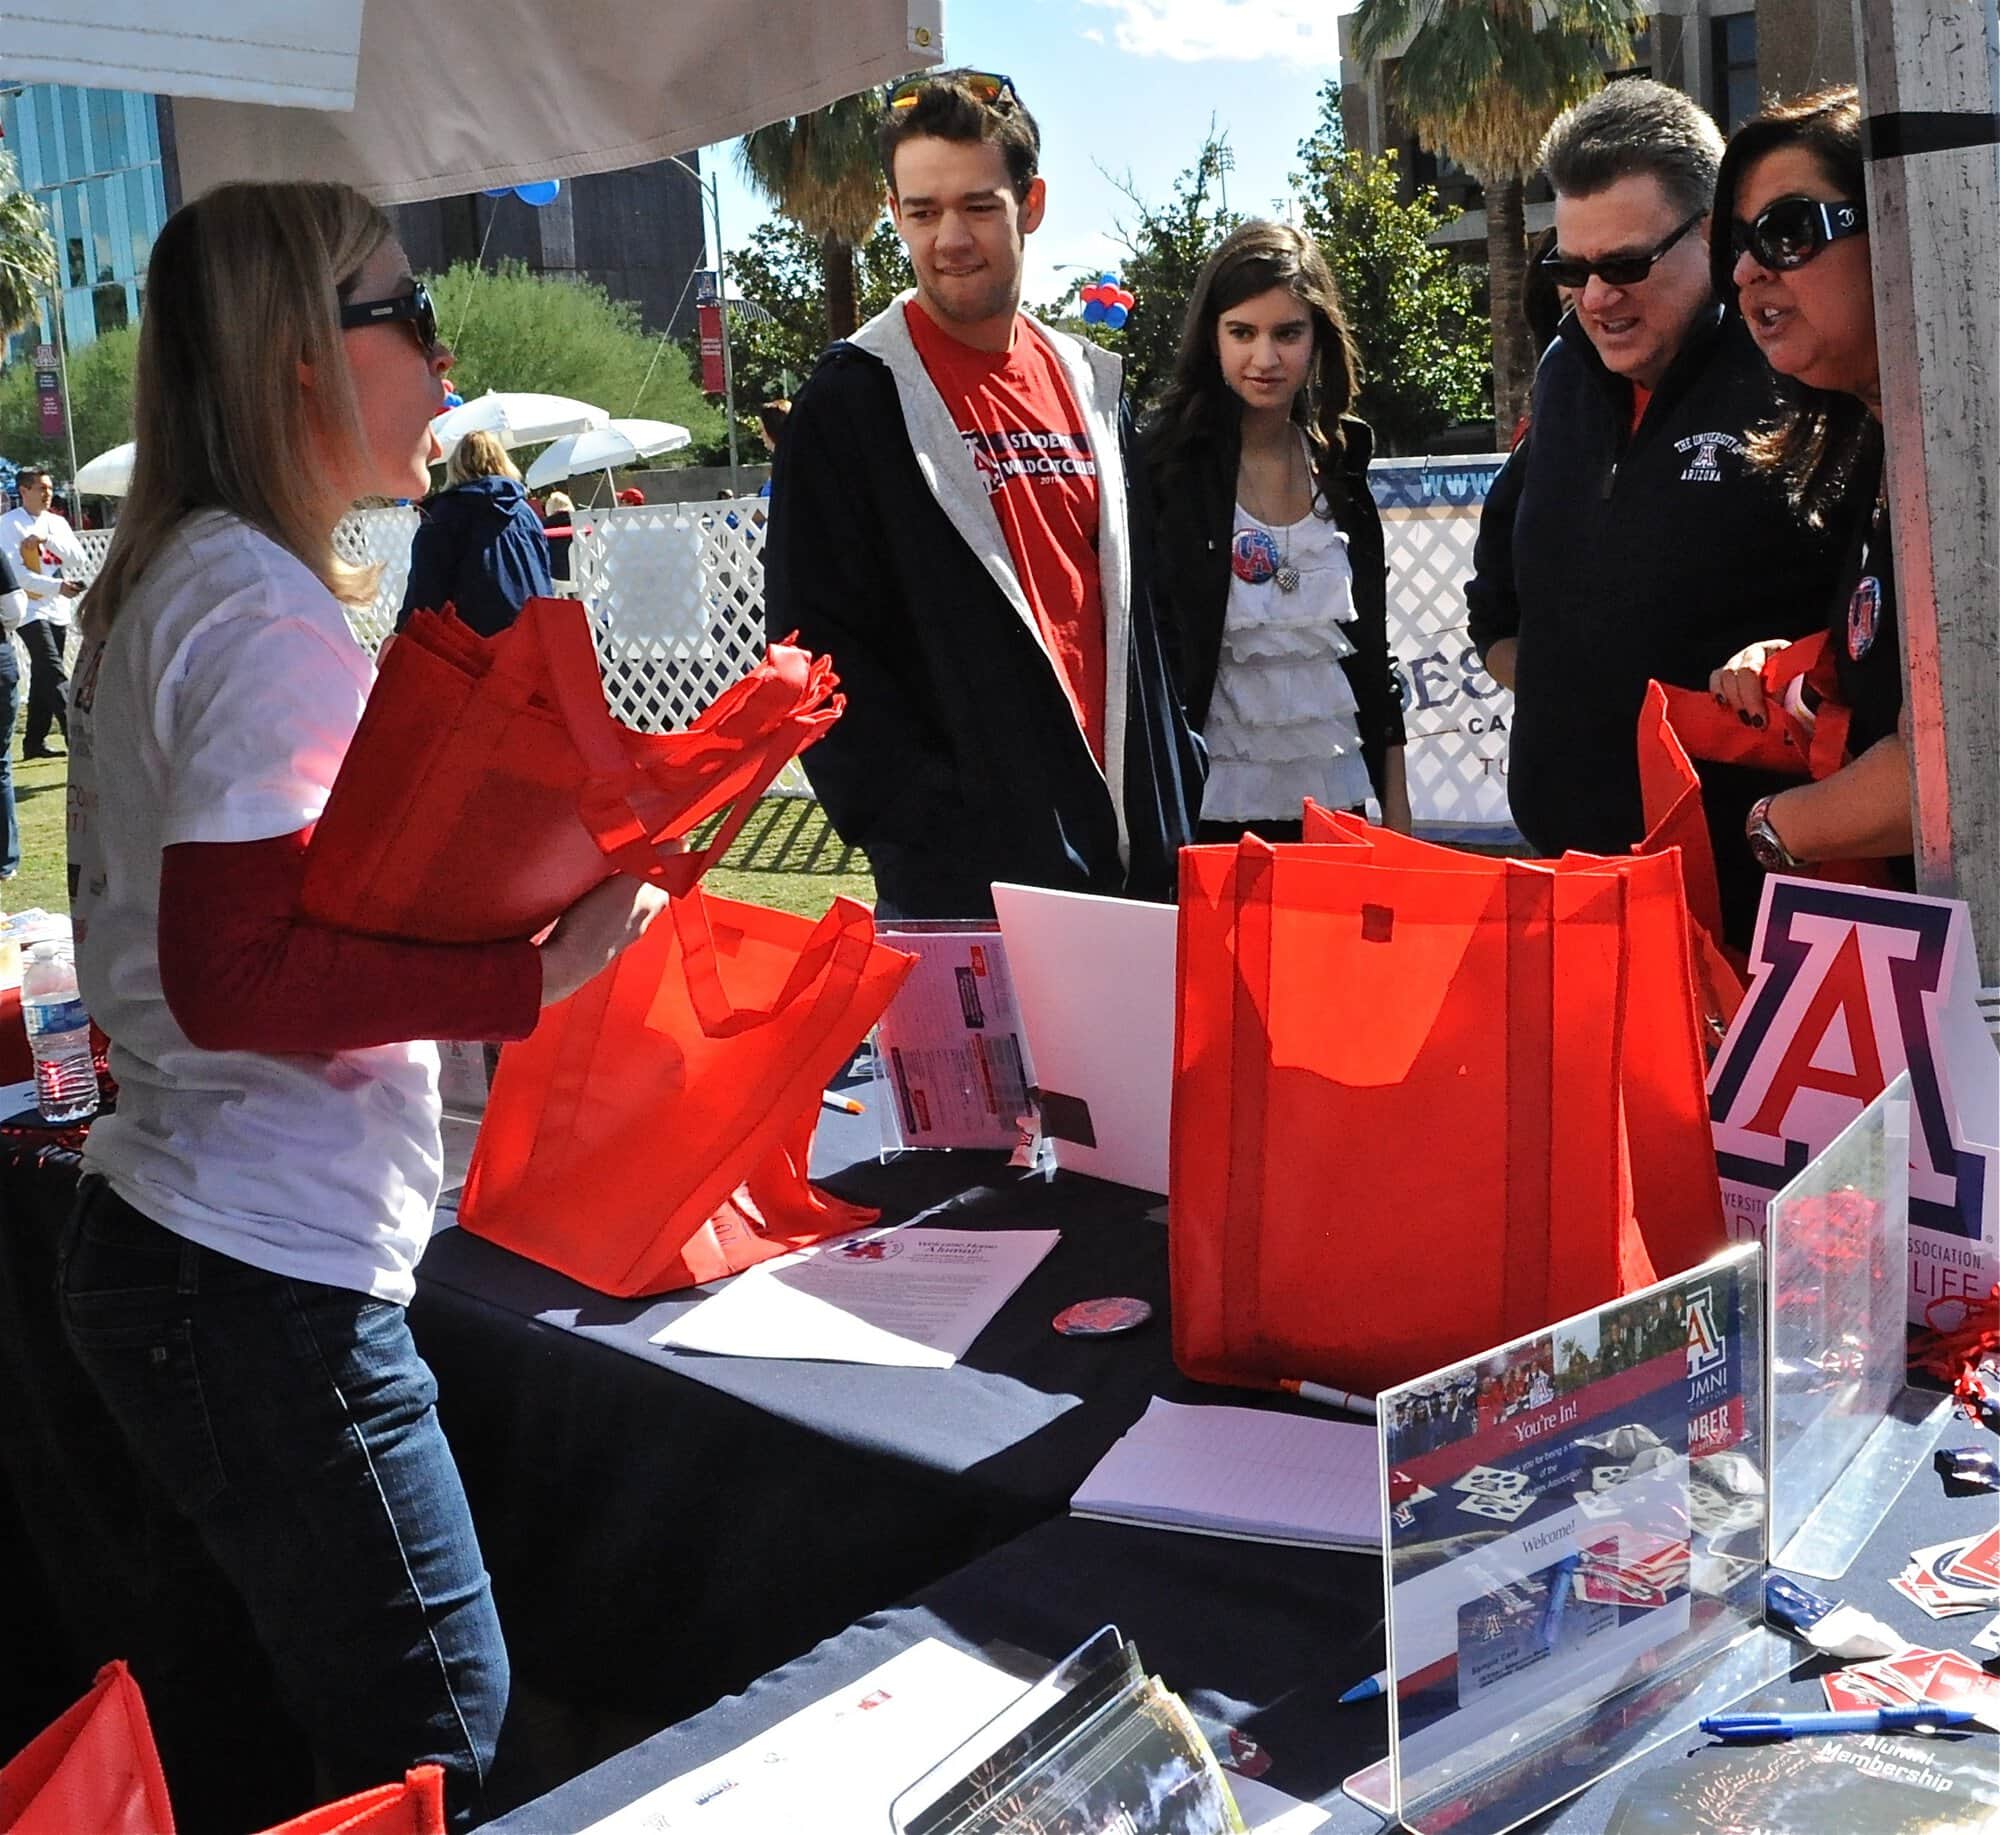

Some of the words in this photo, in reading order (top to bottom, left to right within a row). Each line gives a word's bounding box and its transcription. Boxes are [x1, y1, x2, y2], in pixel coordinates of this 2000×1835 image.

[1010, 432, 1073, 450] STUDENT
[1673, 437, 1693, 453] THE
[1692, 432, 1738, 449] UNIVERSITY
[1680, 469, 1721, 482] ARIZONA
[1515, 1413, 1557, 1442] You're
[1559, 1400, 1578, 1424] In!
[1521, 1519, 1576, 1553] Welcome!
[1859, 1734, 1936, 1766] Alumni
[1817, 1740, 1954, 1793] Membership
